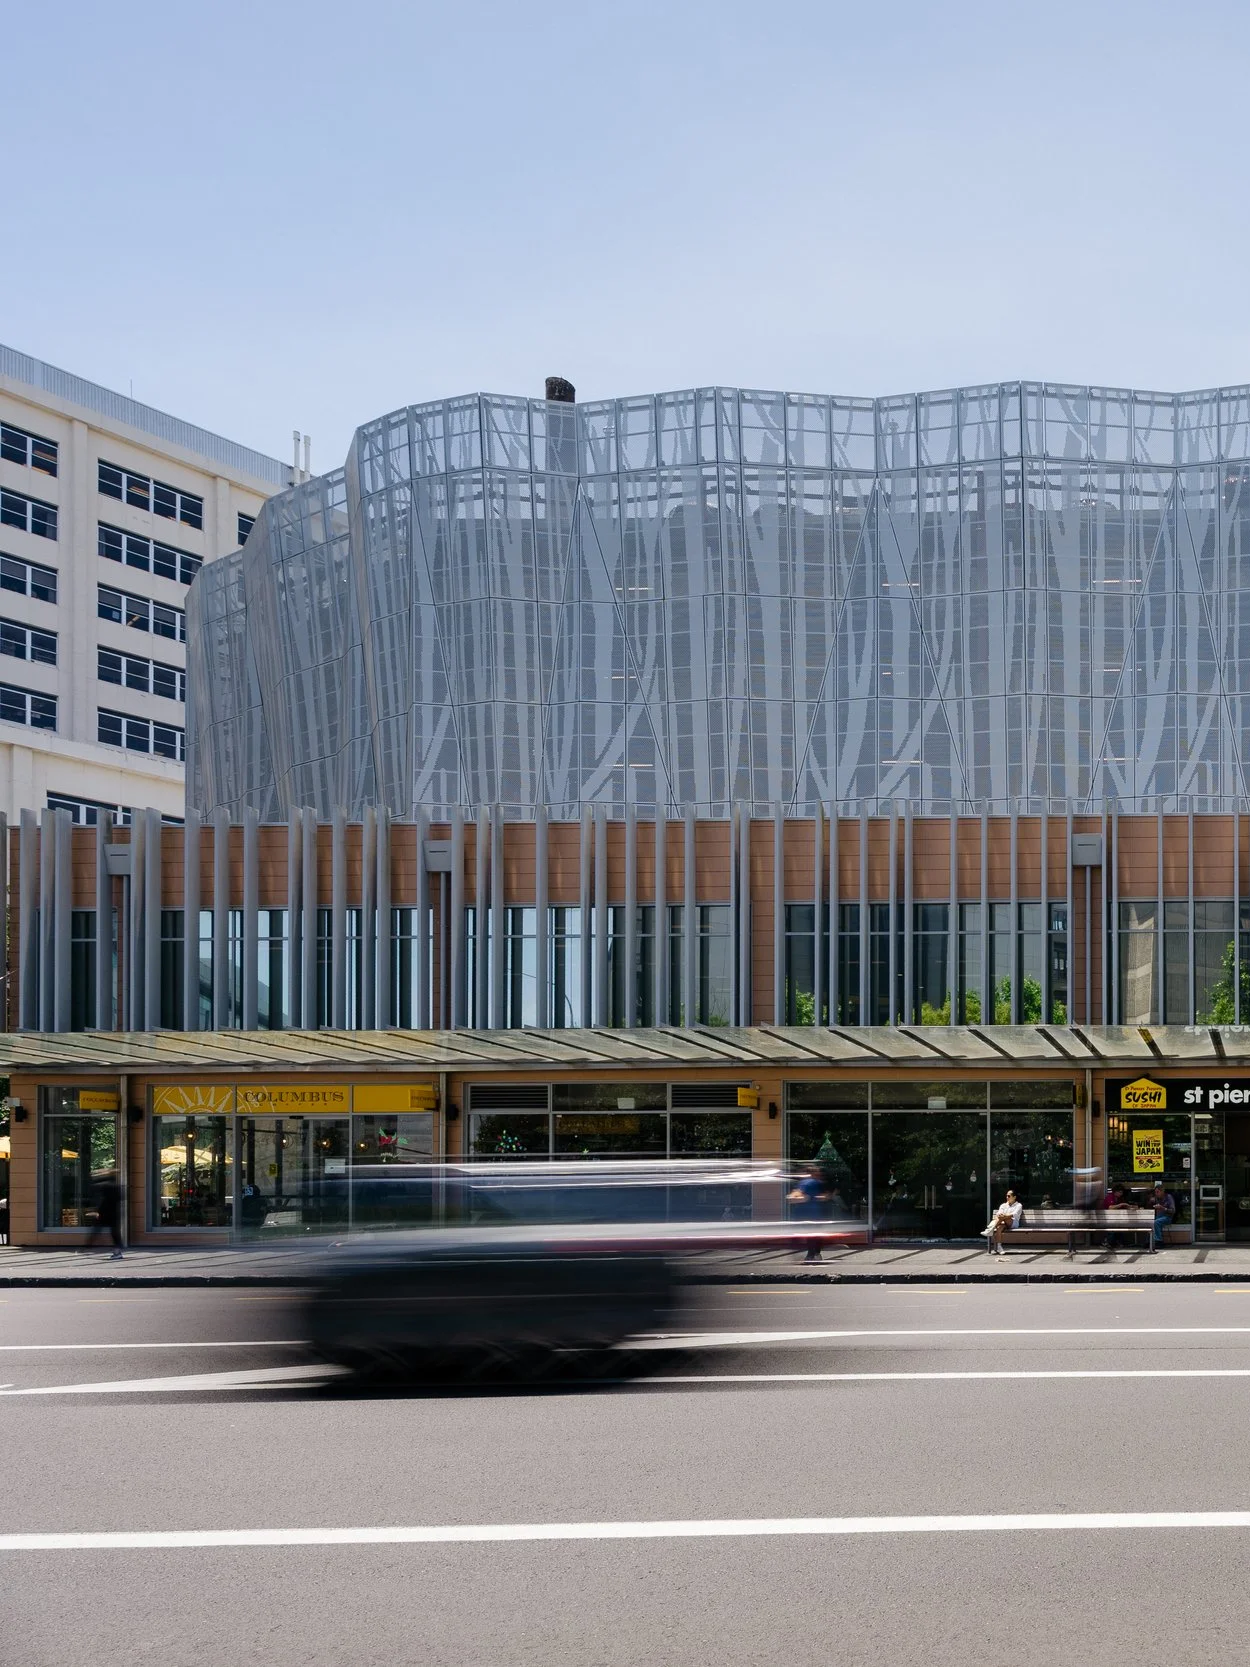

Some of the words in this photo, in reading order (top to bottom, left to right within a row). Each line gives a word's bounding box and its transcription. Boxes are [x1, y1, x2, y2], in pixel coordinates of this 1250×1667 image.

[244, 1091, 344, 1102] COLUMBUS
[1125, 1091, 1162, 1104] SUSHI
[1183, 1086, 1203, 1104] st
